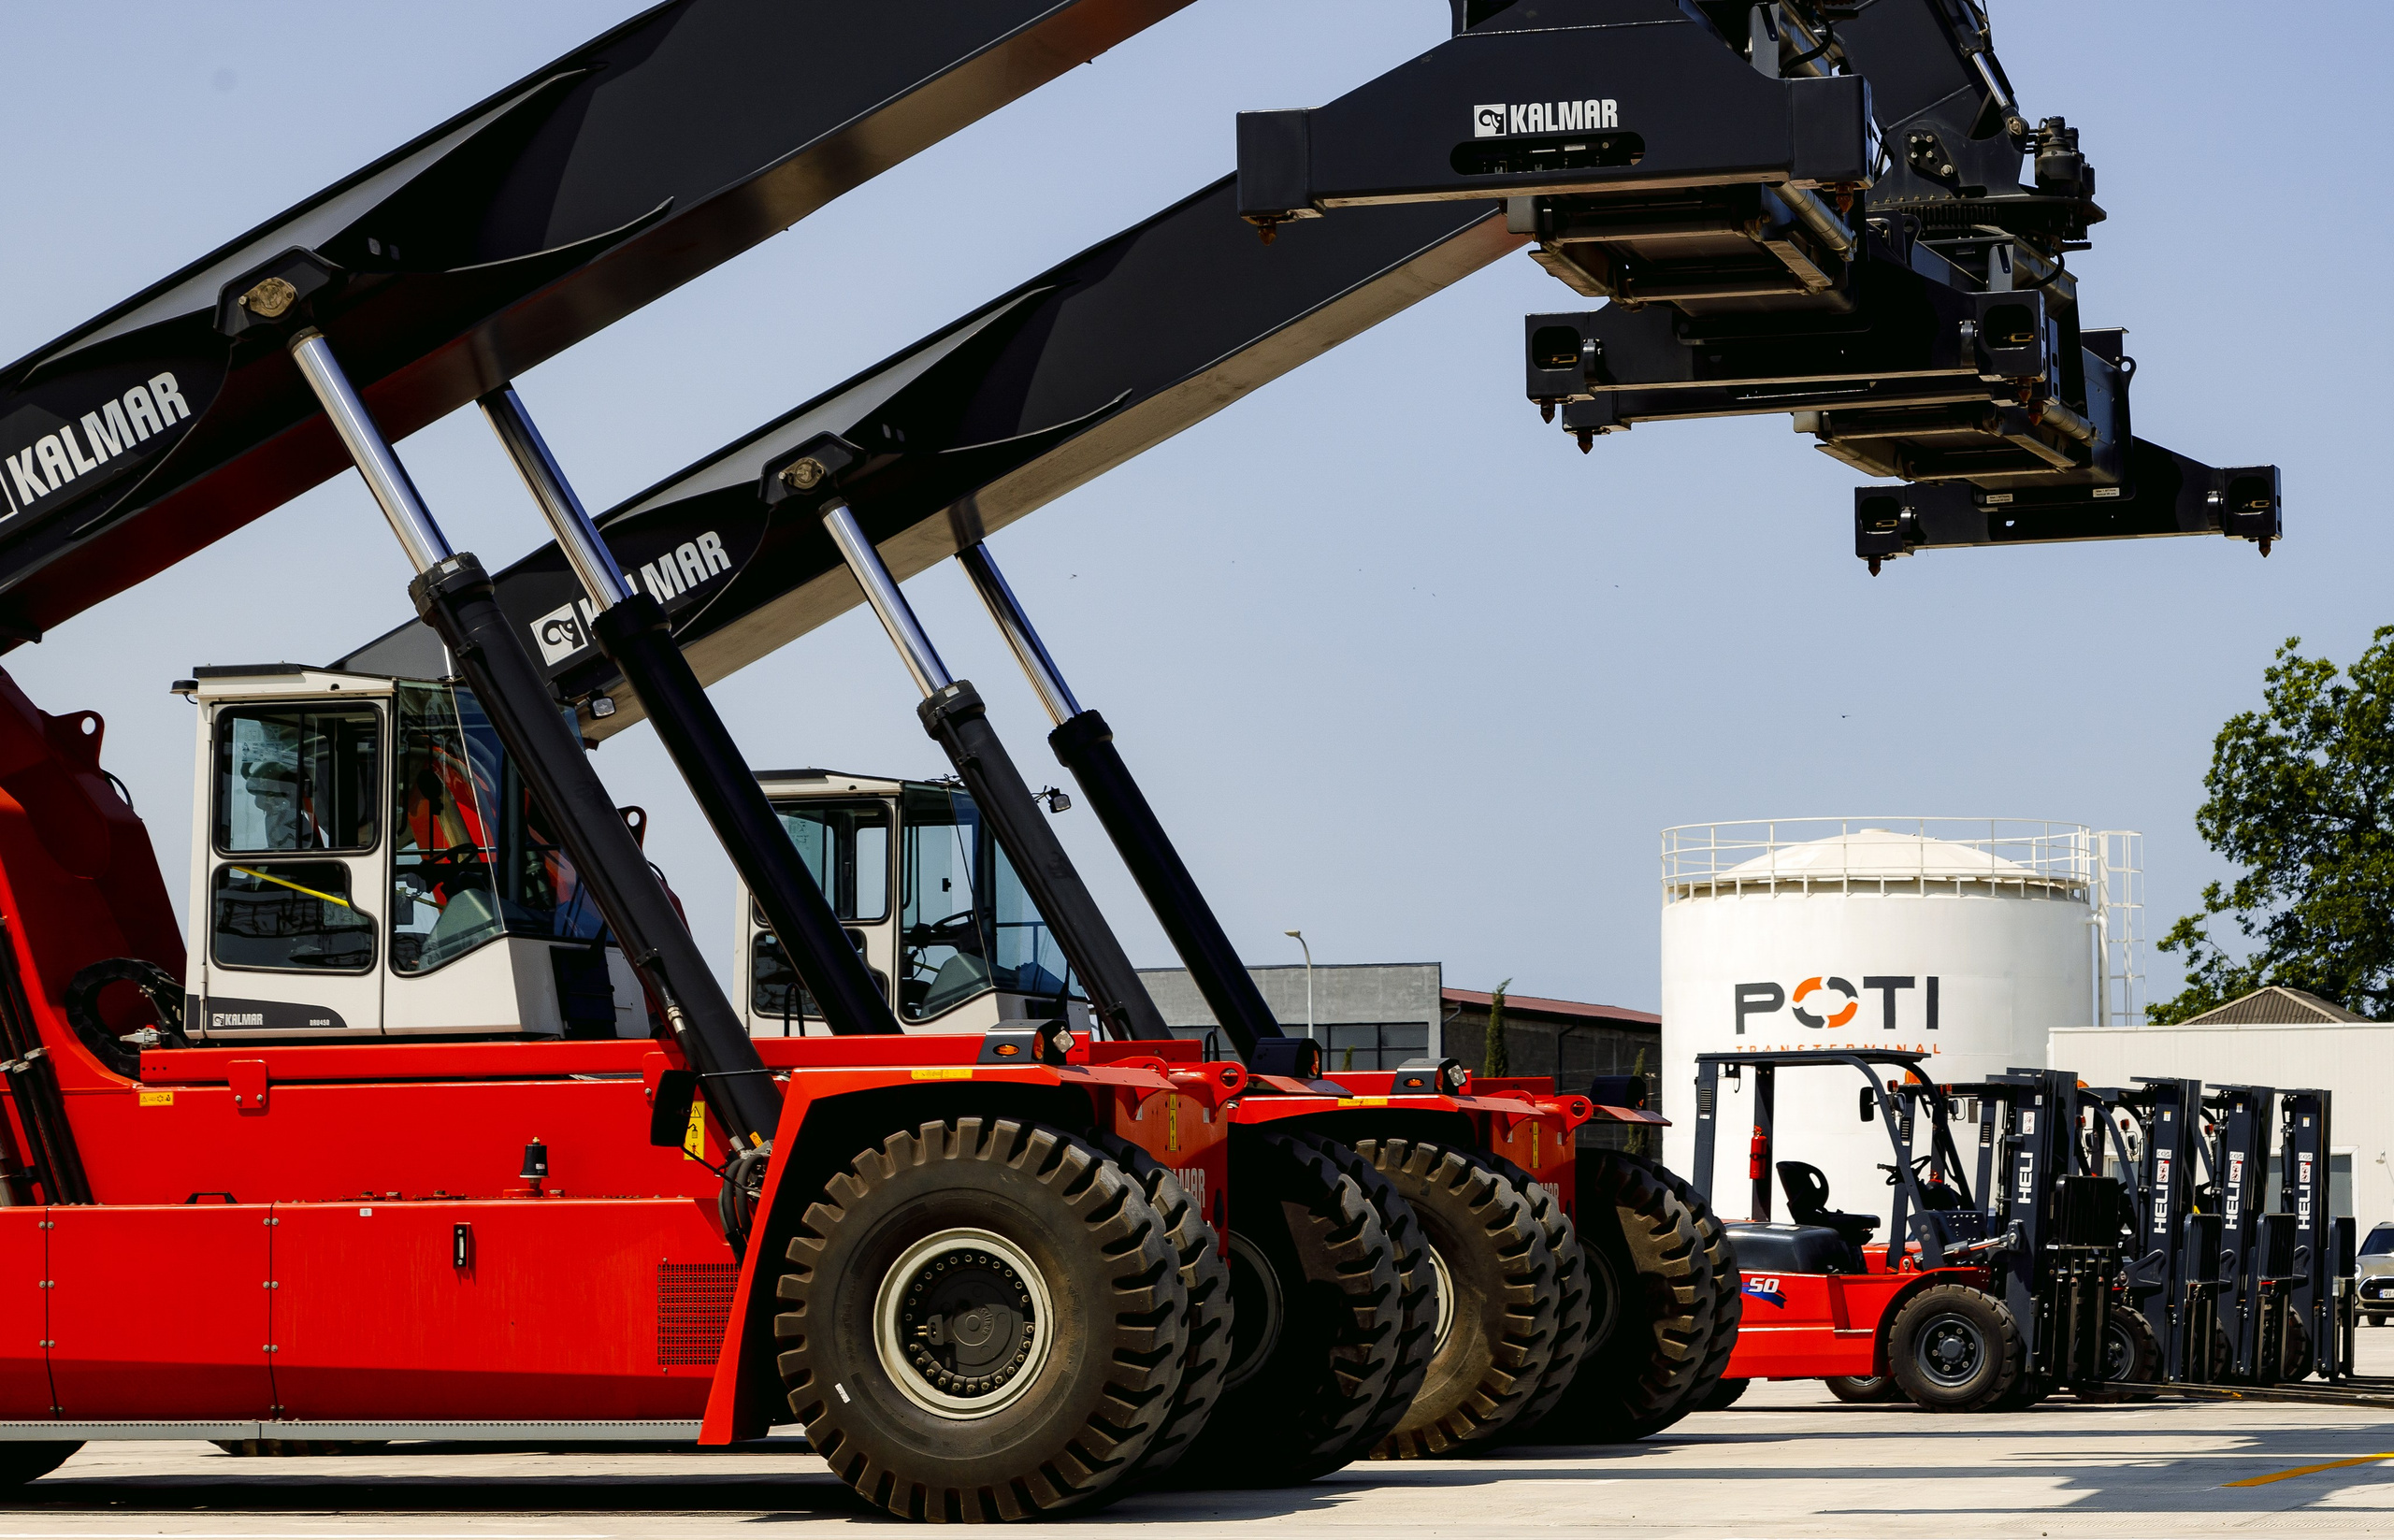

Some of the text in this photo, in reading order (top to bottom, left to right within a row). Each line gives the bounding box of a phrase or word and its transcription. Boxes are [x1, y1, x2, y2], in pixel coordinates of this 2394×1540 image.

[1509, 99, 1619, 134] KALMAR
[6, 371, 192, 506] KALMAR
[224, 1013, 264, 1026] KALMAR
[1735, 976, 1939, 1035] POTI
[2017, 1152, 2034, 1204] HELI
[2153, 1184, 2169, 1234] HELI
[2225, 1182, 2241, 1230] HELI
[2298, 1185, 2311, 1230] HELI
[1748, 1277, 1781, 1293] 50
